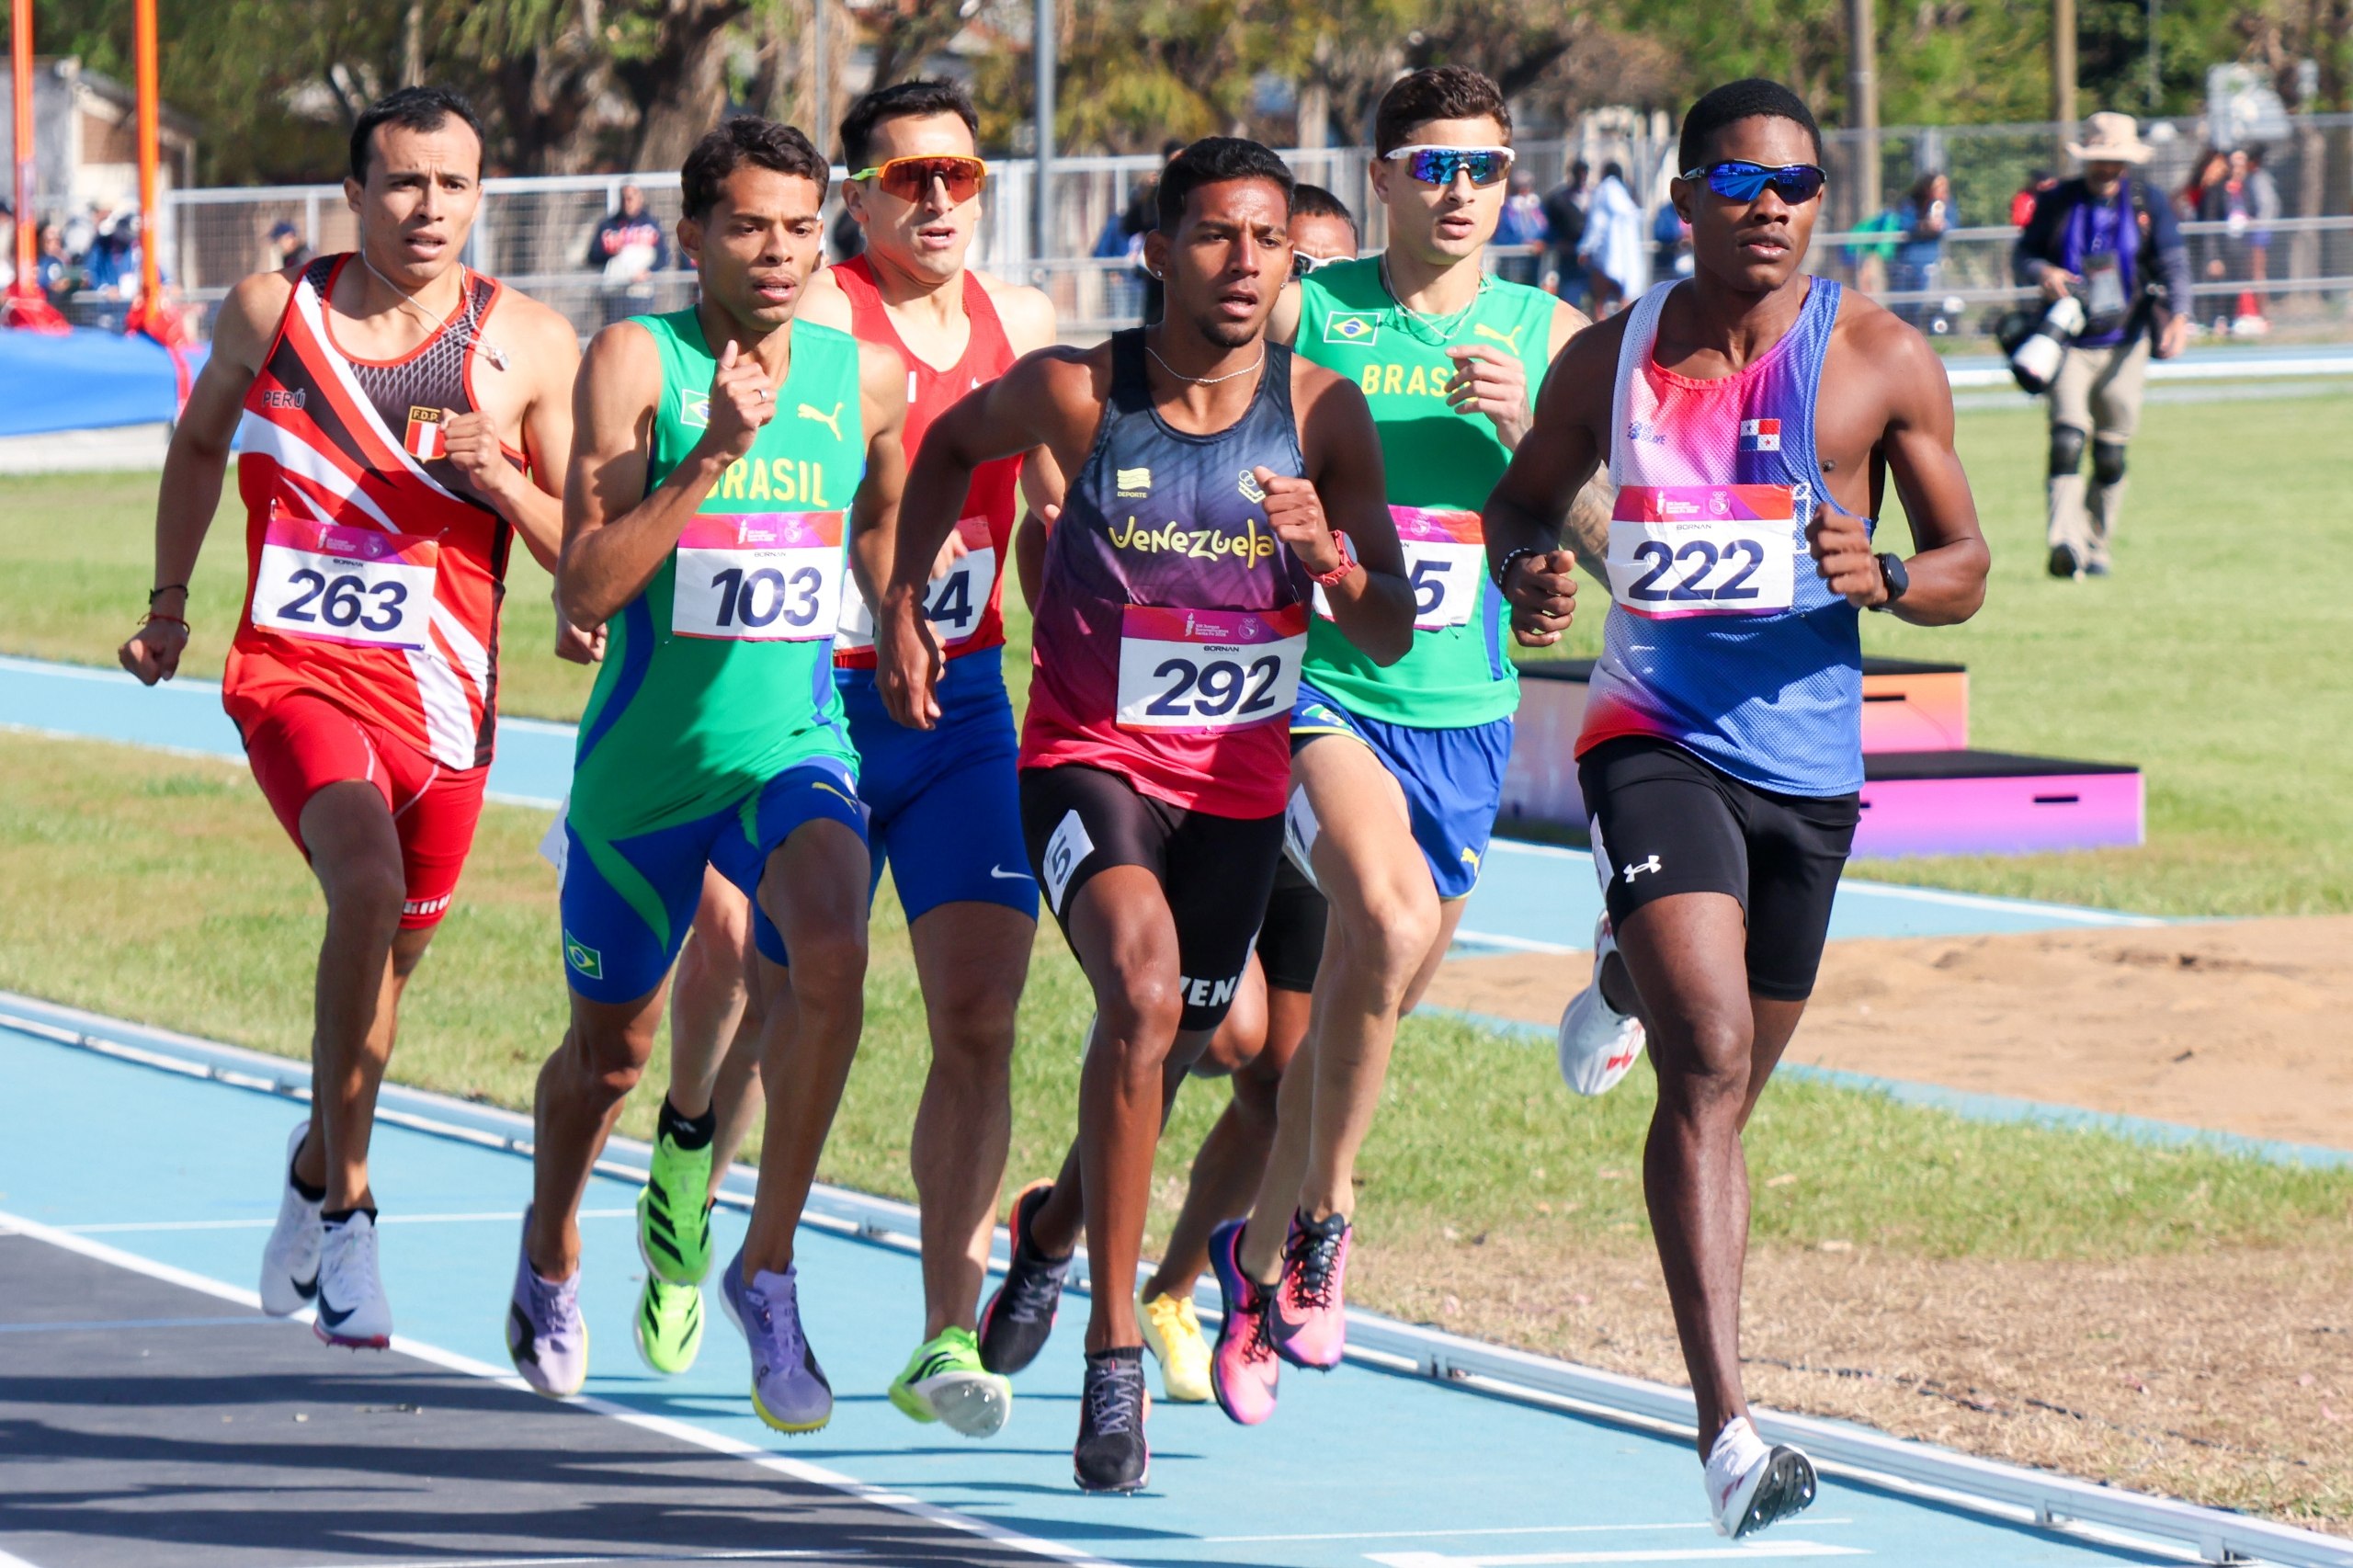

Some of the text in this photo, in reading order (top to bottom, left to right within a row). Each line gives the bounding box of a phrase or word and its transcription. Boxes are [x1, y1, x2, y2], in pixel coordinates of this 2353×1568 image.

[261, 387, 307, 410] PERÚ
[1361, 364, 1478, 403] BRAS
[277, 568, 408, 632] 263
[710, 566, 823, 628] 103
[1628, 539, 1765, 601] 222
[1144, 654, 1281, 717] 292
[1051, 834, 1072, 886] 5
